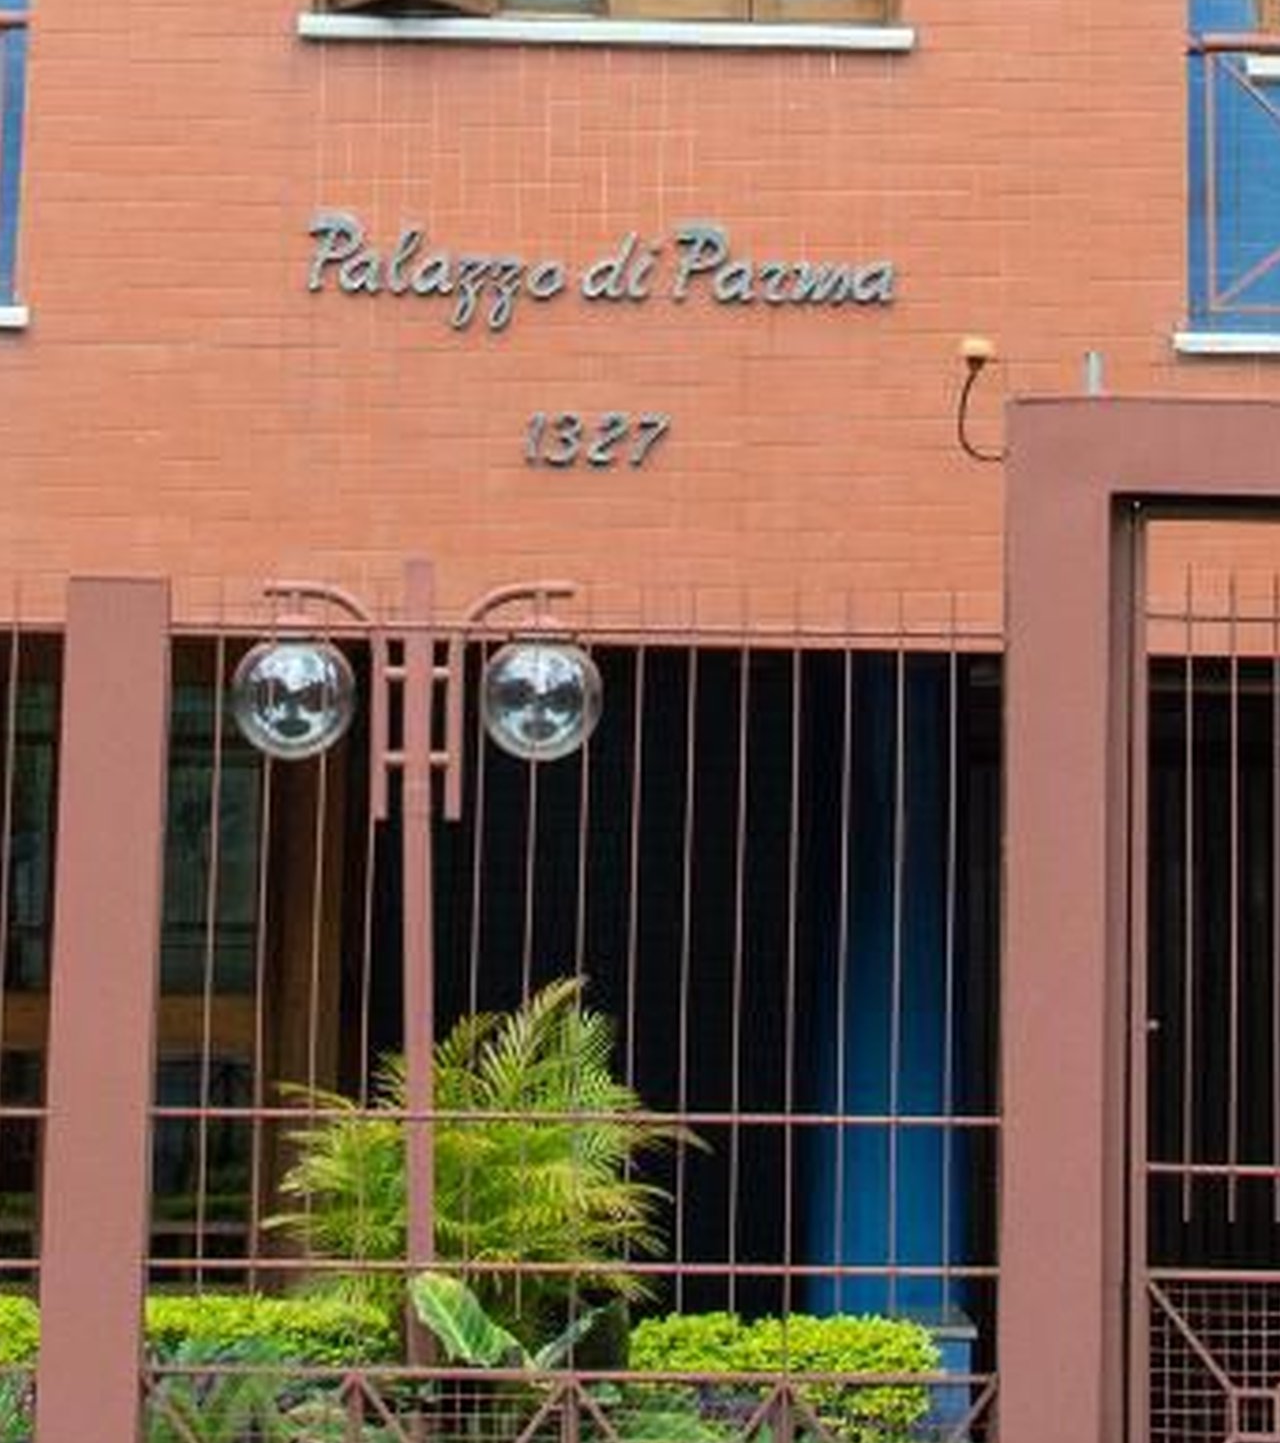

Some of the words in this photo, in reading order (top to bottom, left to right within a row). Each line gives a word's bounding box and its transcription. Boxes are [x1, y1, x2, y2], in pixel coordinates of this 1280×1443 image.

[307, 211, 568, 331] Palazzo
[580, 231, 663, 302] di
[669, 218, 897, 306] Parma
[522, 411, 671, 469] 1327
